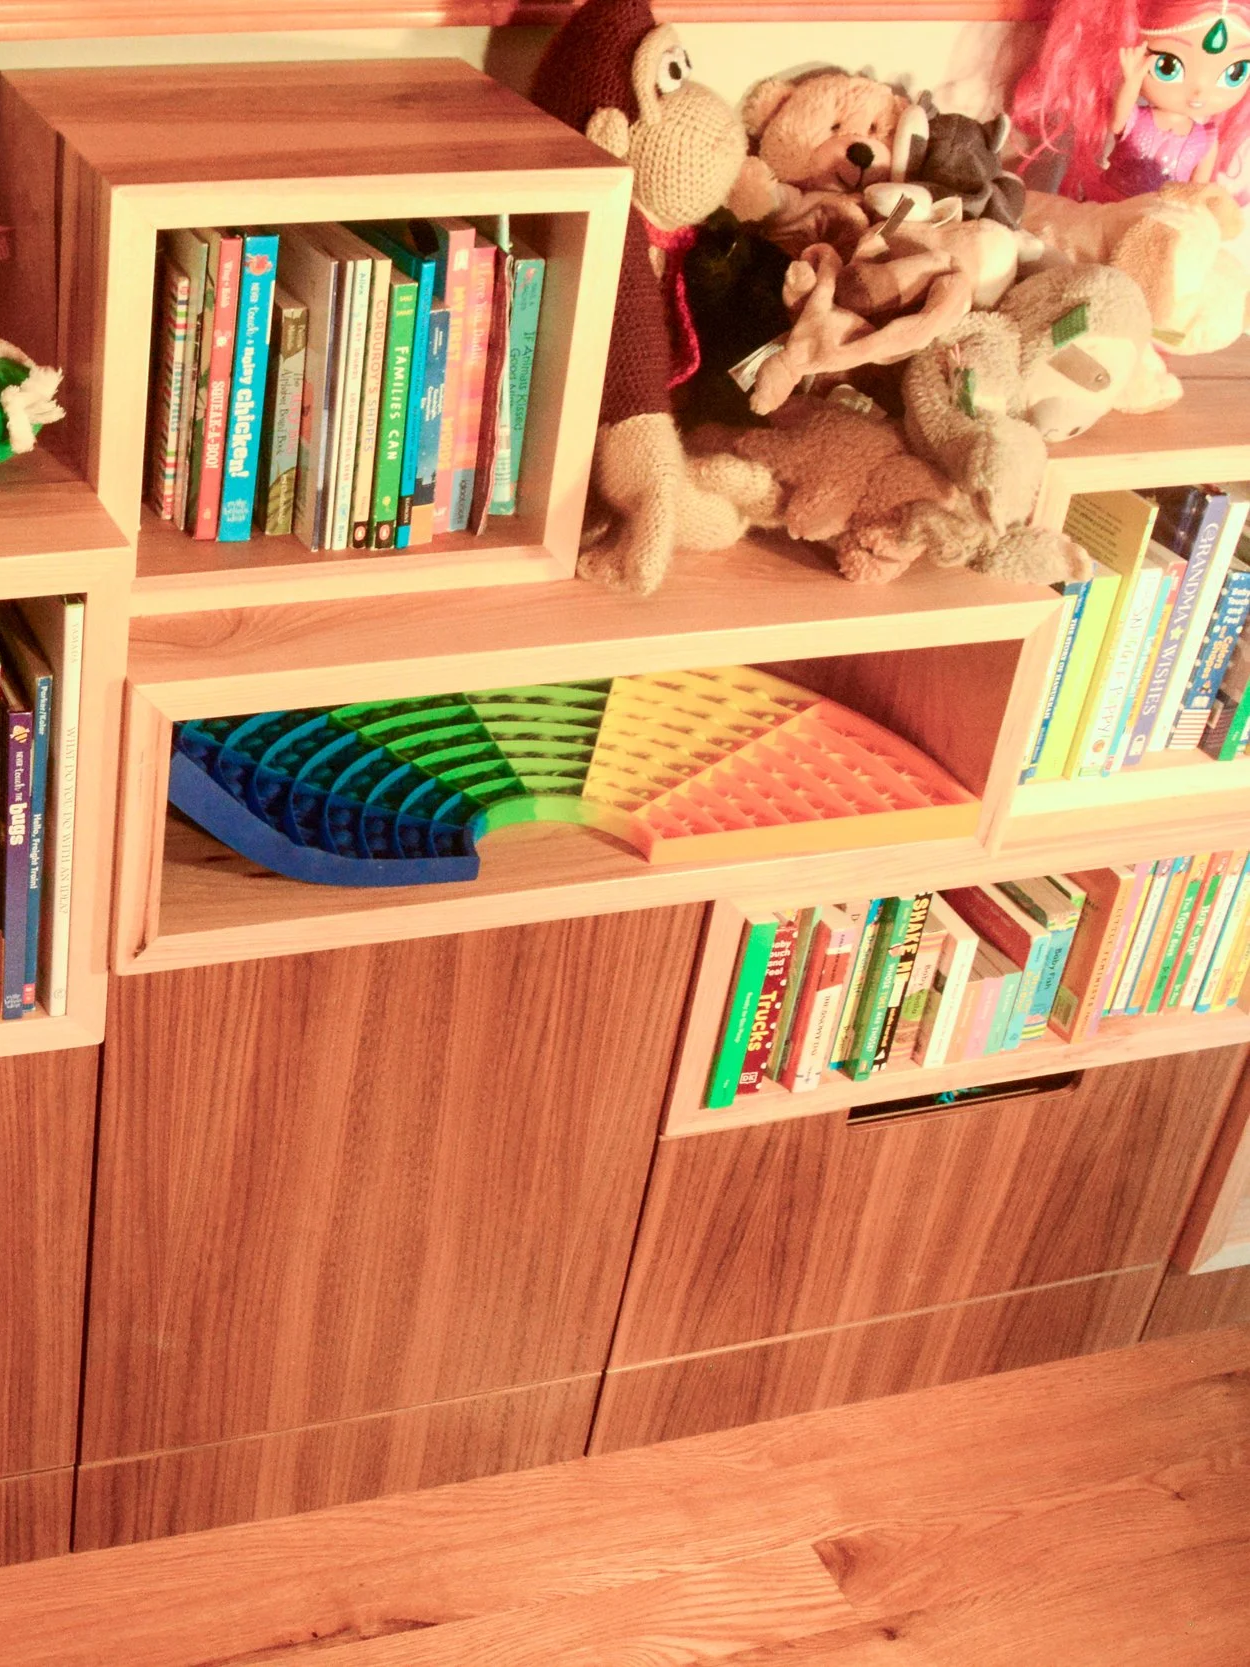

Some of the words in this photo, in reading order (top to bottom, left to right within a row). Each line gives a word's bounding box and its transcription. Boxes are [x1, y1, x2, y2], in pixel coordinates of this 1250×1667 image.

[247, 305, 259, 338] touch
[368, 300, 386, 394] CORDUROY'S
[239, 347, 255, 385] noisy
[519, 344, 534, 391] Animals
[390, 346, 409, 420] FAMILIES
[206, 380, 225, 469] SQUEAK-A-BOO!
[278, 408, 288, 433] Board
[514, 393, 527, 431] Kissed
[229, 388, 255, 478] chicken!
[364, 404, 378, 452] SHAPES
[276, 435, 287, 456] Book
[386, 429, 400, 460] CAN
[1173, 523, 1219, 624] GRANDMA
[1067, 617, 1078, 635] THE
[1061, 635, 1073, 660] STORY
[1057, 661, 1066, 673] OF
[1142, 645, 1177, 717] WISHES
[1044, 673, 1062, 720] HANUKKAH
[65, 726, 76, 761] WHAT
[14, 767, 25, 793] touch
[64, 764, 75, 782] DO
[63, 783, 74, 808] YOU
[9, 802, 28, 847] bugs
[33, 813, 43, 837] Hello,
[62, 811, 73, 830] DO
[31, 838, 41, 866] Freight
[61, 833, 72, 863] WITH
[30, 866, 40, 890] Train!
[60, 866, 70, 884] AN
[58, 887, 69, 914] IDEA?
[1197, 905, 1211, 922] HOP
[902, 897, 930, 956] SHAKE
[1173, 913, 1187, 937] FOOT
[1167, 939, 1178, 957] Book
[1187, 930, 1201, 955] POP
[1049, 947, 1063, 970] Baby
[882, 962, 895, 990] WHOSE
[919, 964, 932, 986] Baby
[1043, 970, 1056, 989] Fish
[747, 990, 778, 1052] Trucks
[817, 1007, 828, 1040] SNOWY
[876, 1010, 885, 1023] ARE
[811, 1042, 820, 1057] DAY
[866, 1024, 881, 1053] THOSE?
[741, 1073, 757, 1084] DK
